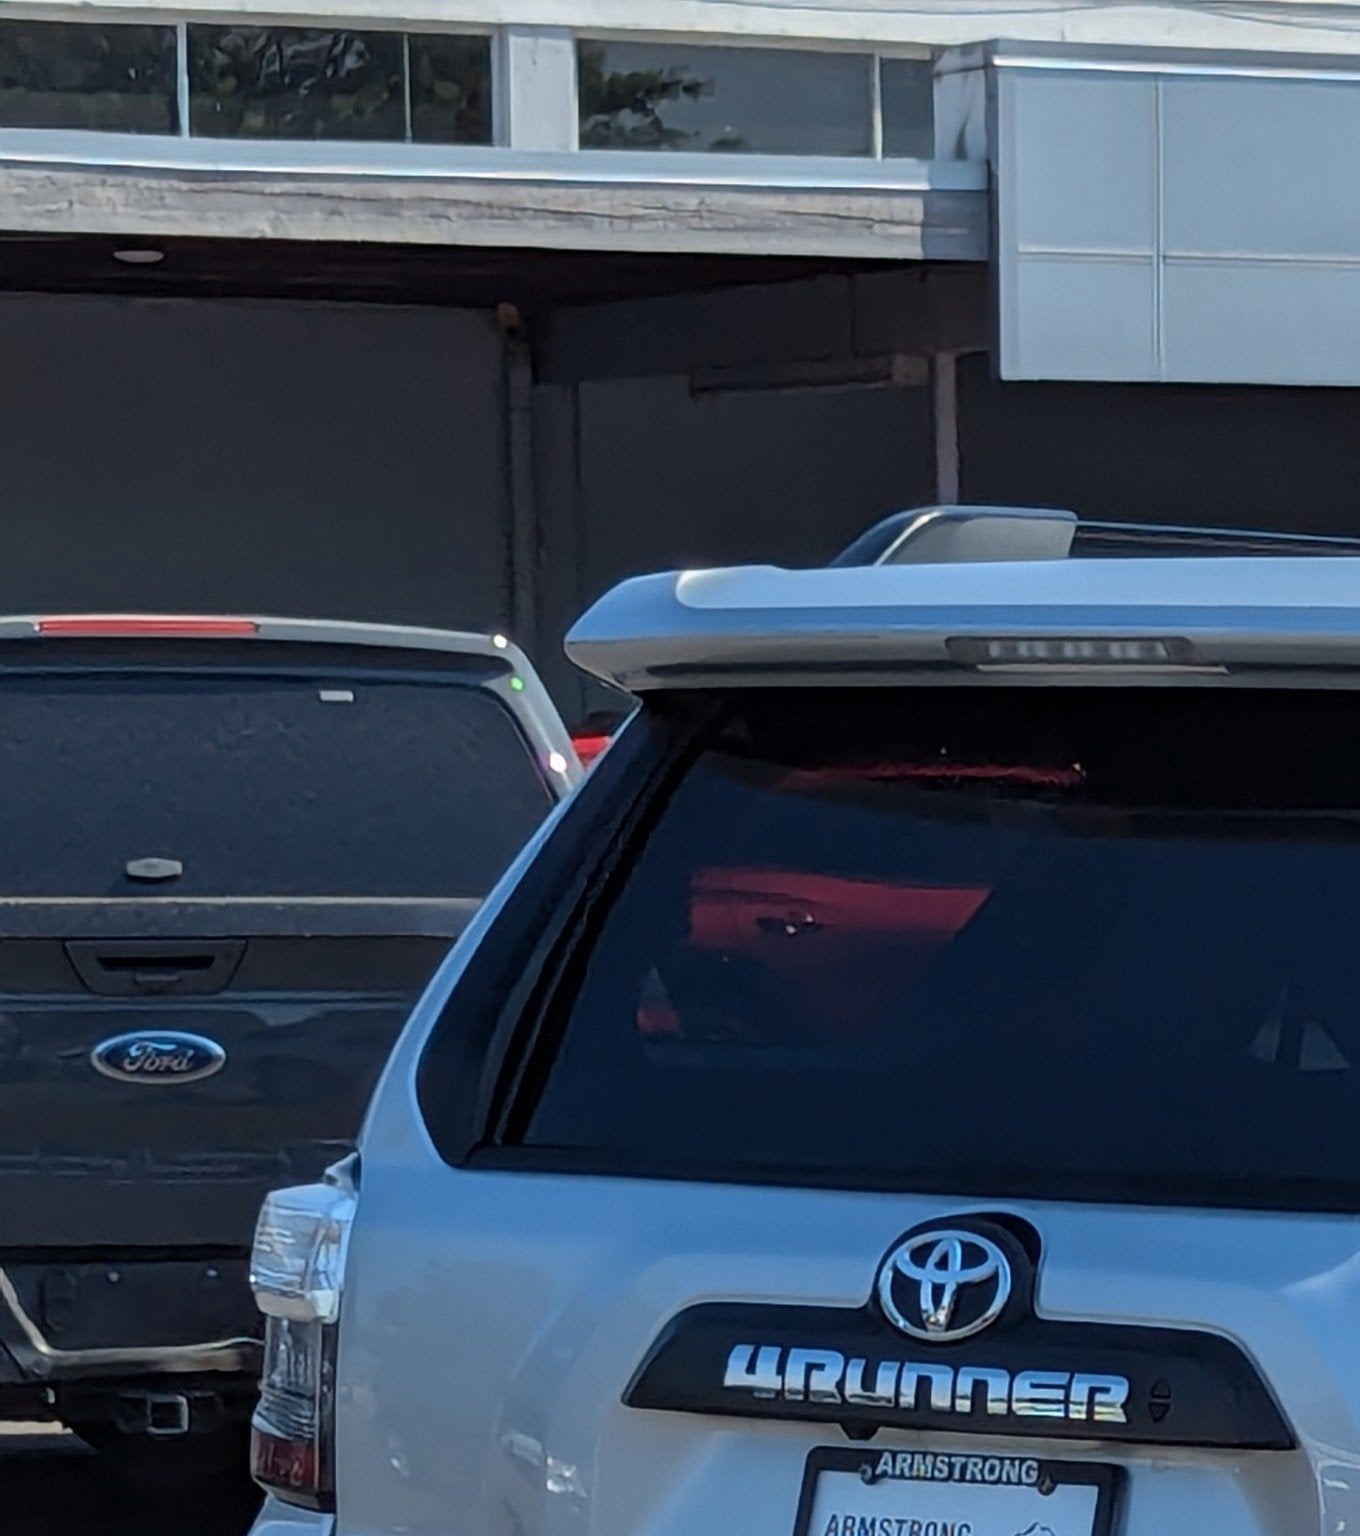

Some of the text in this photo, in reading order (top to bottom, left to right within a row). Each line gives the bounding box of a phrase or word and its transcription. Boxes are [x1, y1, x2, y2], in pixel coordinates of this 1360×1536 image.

[123, 1041, 195, 1071] Ford
[723, 1344, 1130, 1424] 4RUNNER
[875, 1450, 1039, 1486] ARMSTRONG
